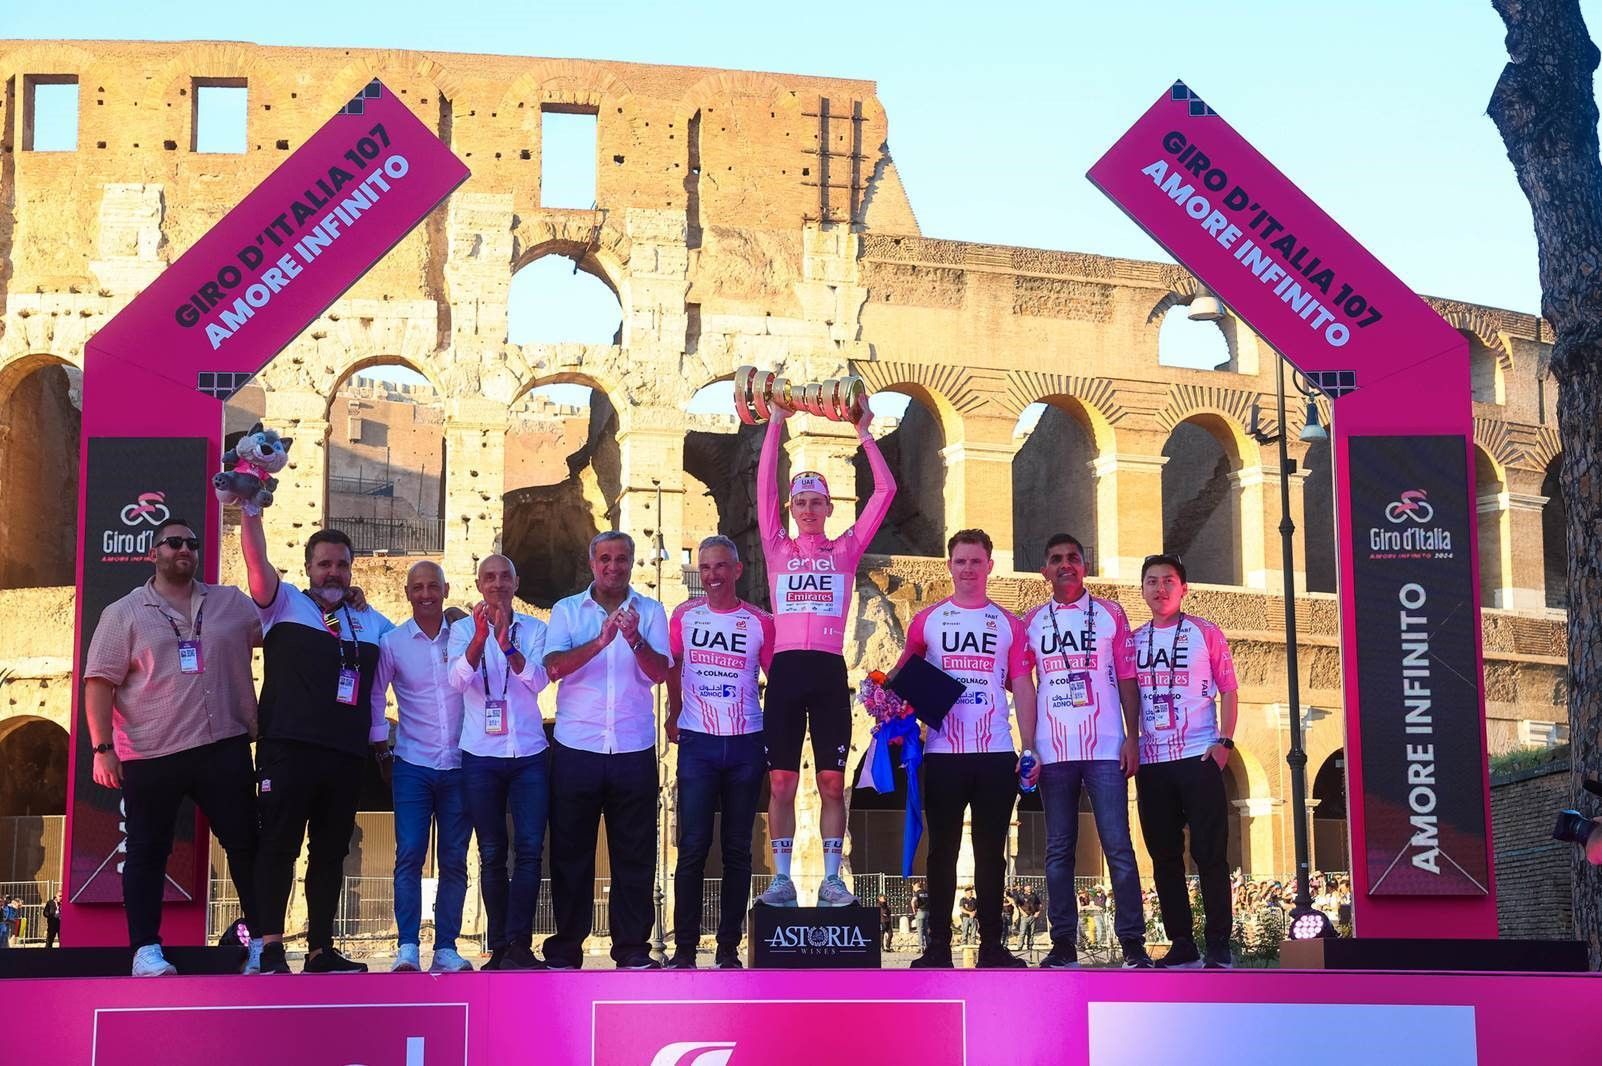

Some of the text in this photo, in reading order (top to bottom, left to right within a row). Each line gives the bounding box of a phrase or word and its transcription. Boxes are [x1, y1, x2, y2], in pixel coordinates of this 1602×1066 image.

[175, 123, 391, 328] GIRO D'ITALIA 107
[1162, 131, 1383, 329] GIRO D'ITALIA 107
[205, 155, 409, 350] AMORE INFINITO
[1141, 159, 1350, 347] AMORE INFINITO
[103, 530, 134, 553] Giro
[1370, 527, 1451, 550] Giro d'Italia
[787, 555, 836, 571] enel
[788, 574, 832, 591] UAE
[787, 592, 832, 602] Emirates
[691, 628, 747, 654] UAE
[942, 631, 998, 655] UAE
[1041, 630, 1097, 655] UAE
[690, 650, 745, 669] Emirates
[943, 656, 993, 671] Emirates
[1137, 647, 1188, 669] UAE
[704, 670, 738, 678] COLNAGO
[1053, 700, 1073, 708] ADNO
[1399, 582, 1441, 875] AMORE INFINITO
[769, 926, 867, 947] ASTORIA
